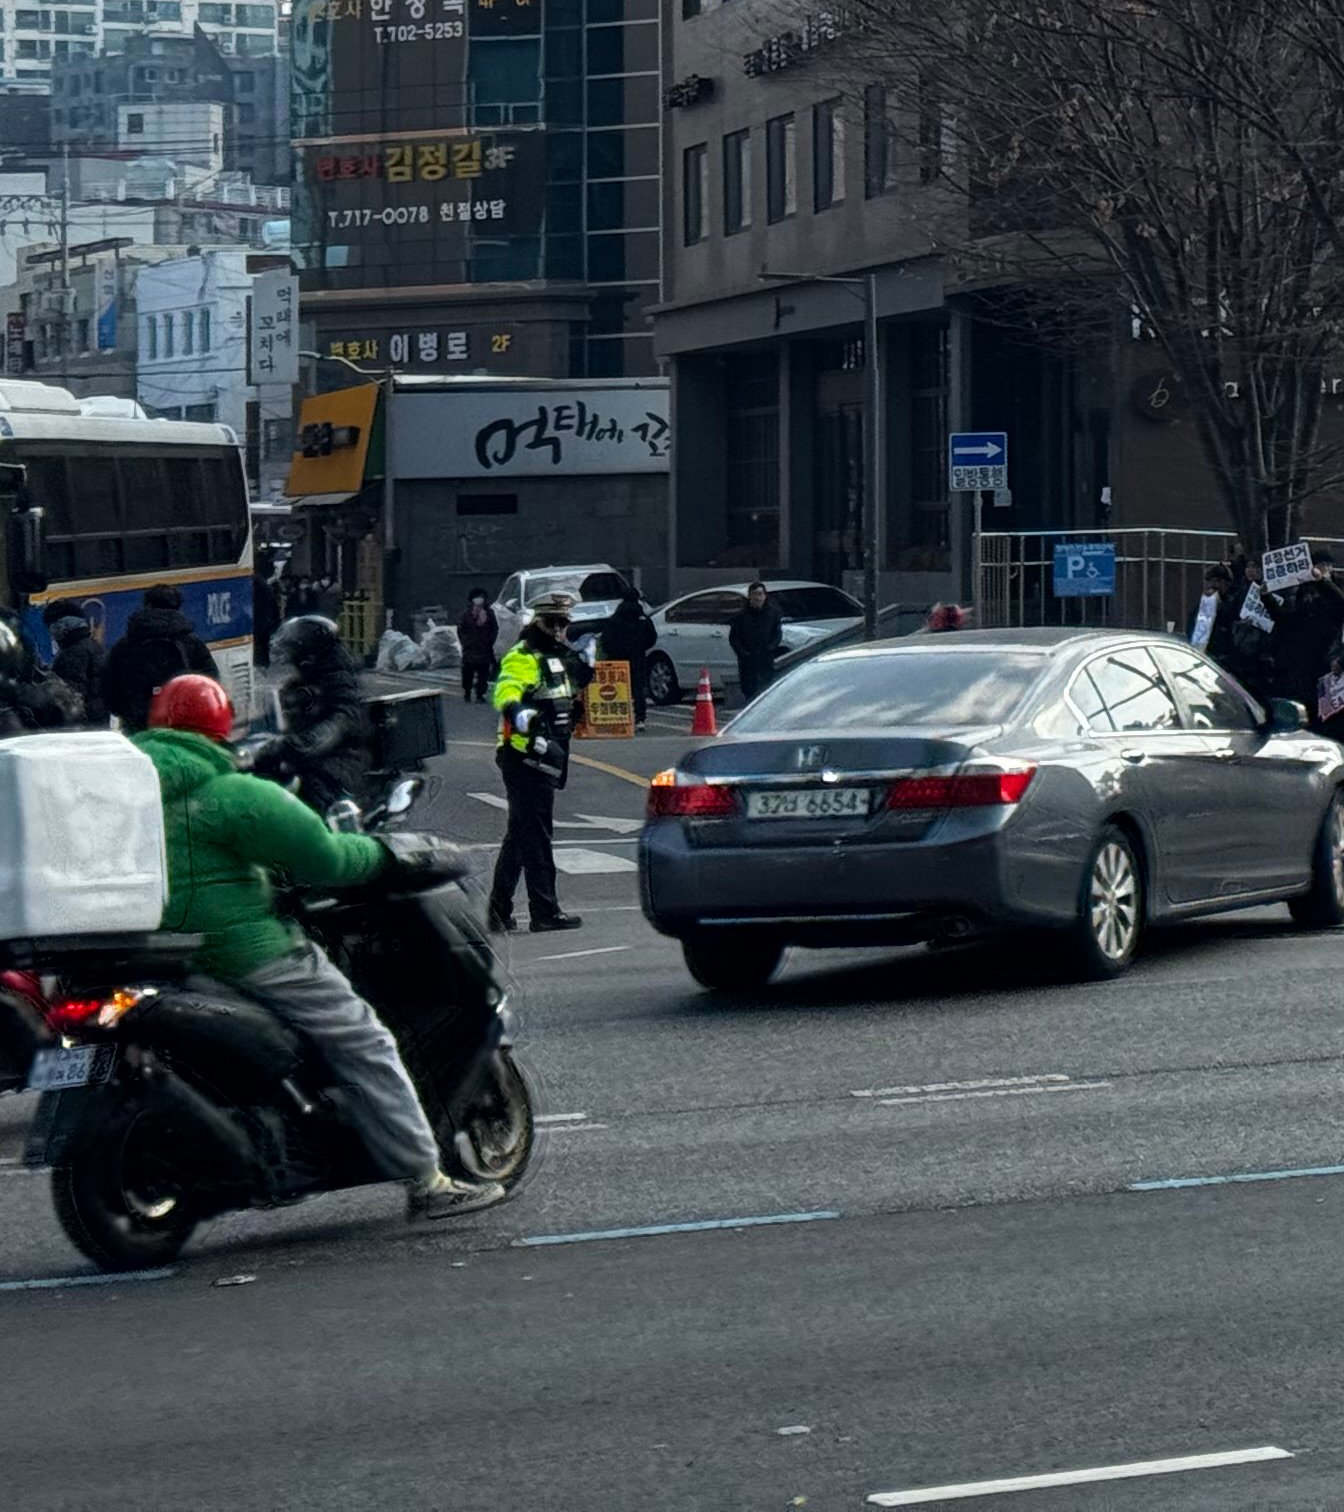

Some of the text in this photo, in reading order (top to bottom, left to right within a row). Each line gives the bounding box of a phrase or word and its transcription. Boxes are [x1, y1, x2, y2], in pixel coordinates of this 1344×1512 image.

[374, 21, 464, 44] T.702-5253
[385, 141, 483, 184] 김정길
[327, 199, 507, 229] T.717-0078 친절상담
[491, 334, 512, 354] 2F
[1067, 556, 1085, 579] P
[806, 791, 858, 813] 6654
